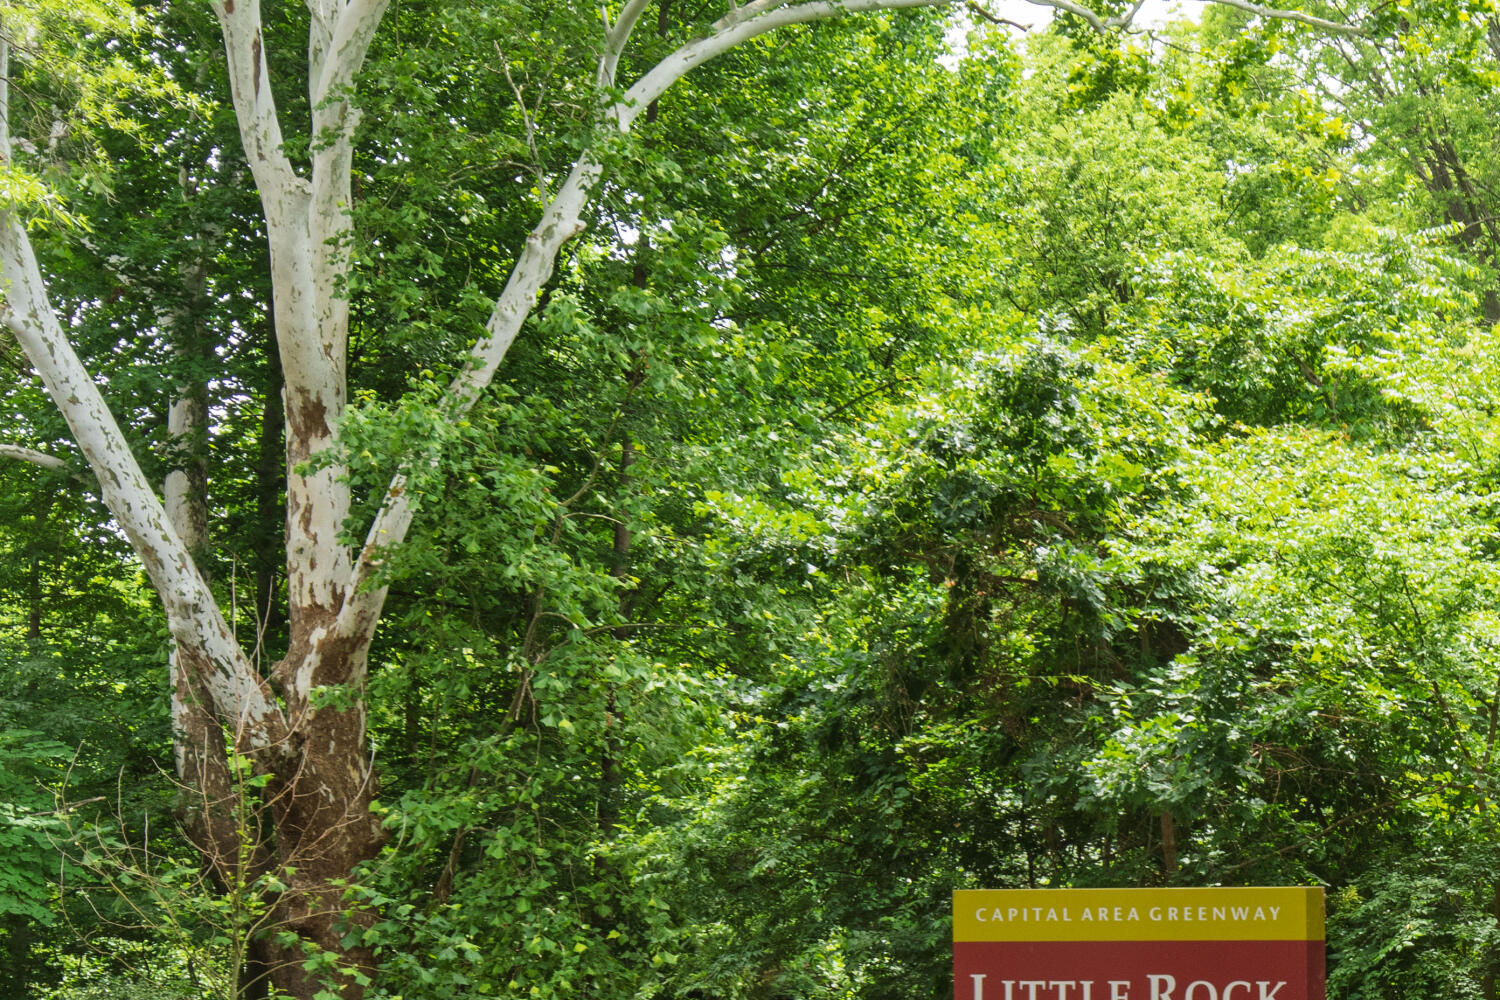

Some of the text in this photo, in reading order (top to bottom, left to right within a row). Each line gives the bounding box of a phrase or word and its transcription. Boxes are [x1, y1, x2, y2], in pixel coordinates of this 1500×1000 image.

[975, 906, 1282, 922] CAPITAL AREA GREENWAY
